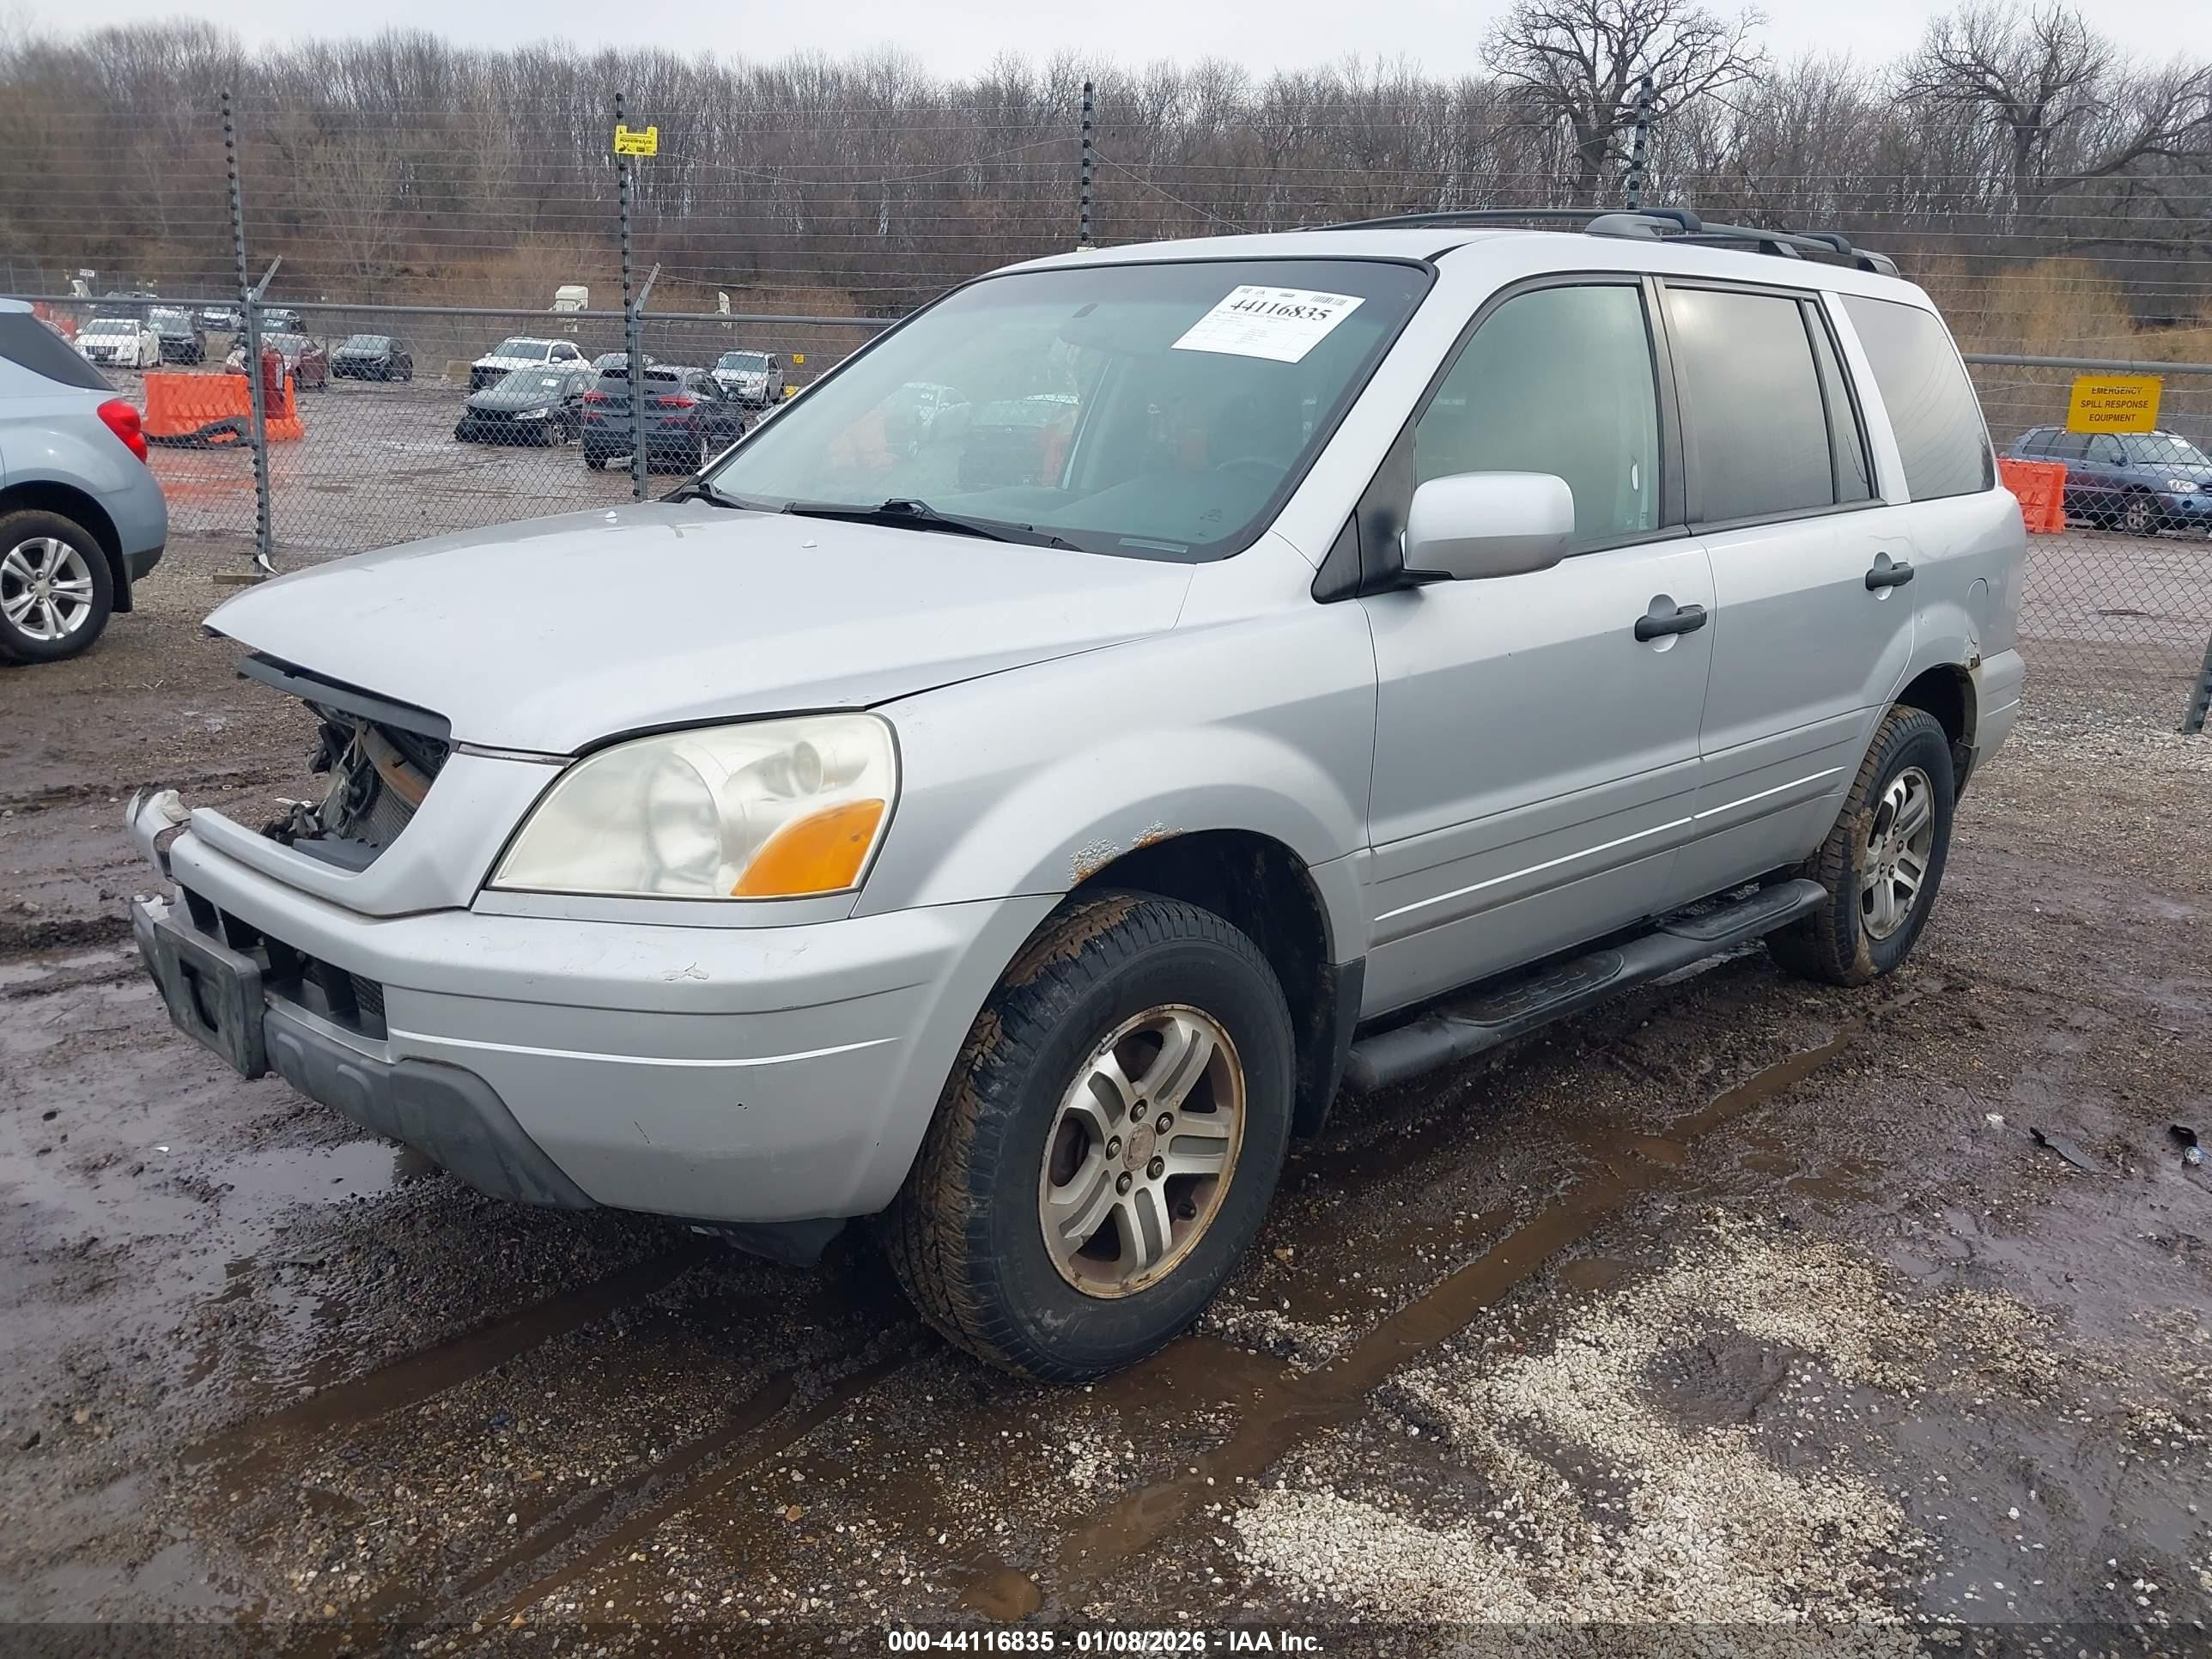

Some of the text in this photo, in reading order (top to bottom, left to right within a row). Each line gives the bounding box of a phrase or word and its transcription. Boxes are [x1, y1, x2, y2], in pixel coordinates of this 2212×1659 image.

[1230, 299, 1333, 321] 44116835
[2091, 386, 2143, 395] EMERGENCY
[2105, 400, 2148, 409] RESPONSE
[2088, 413, 2136, 422] EQUIPMENT
